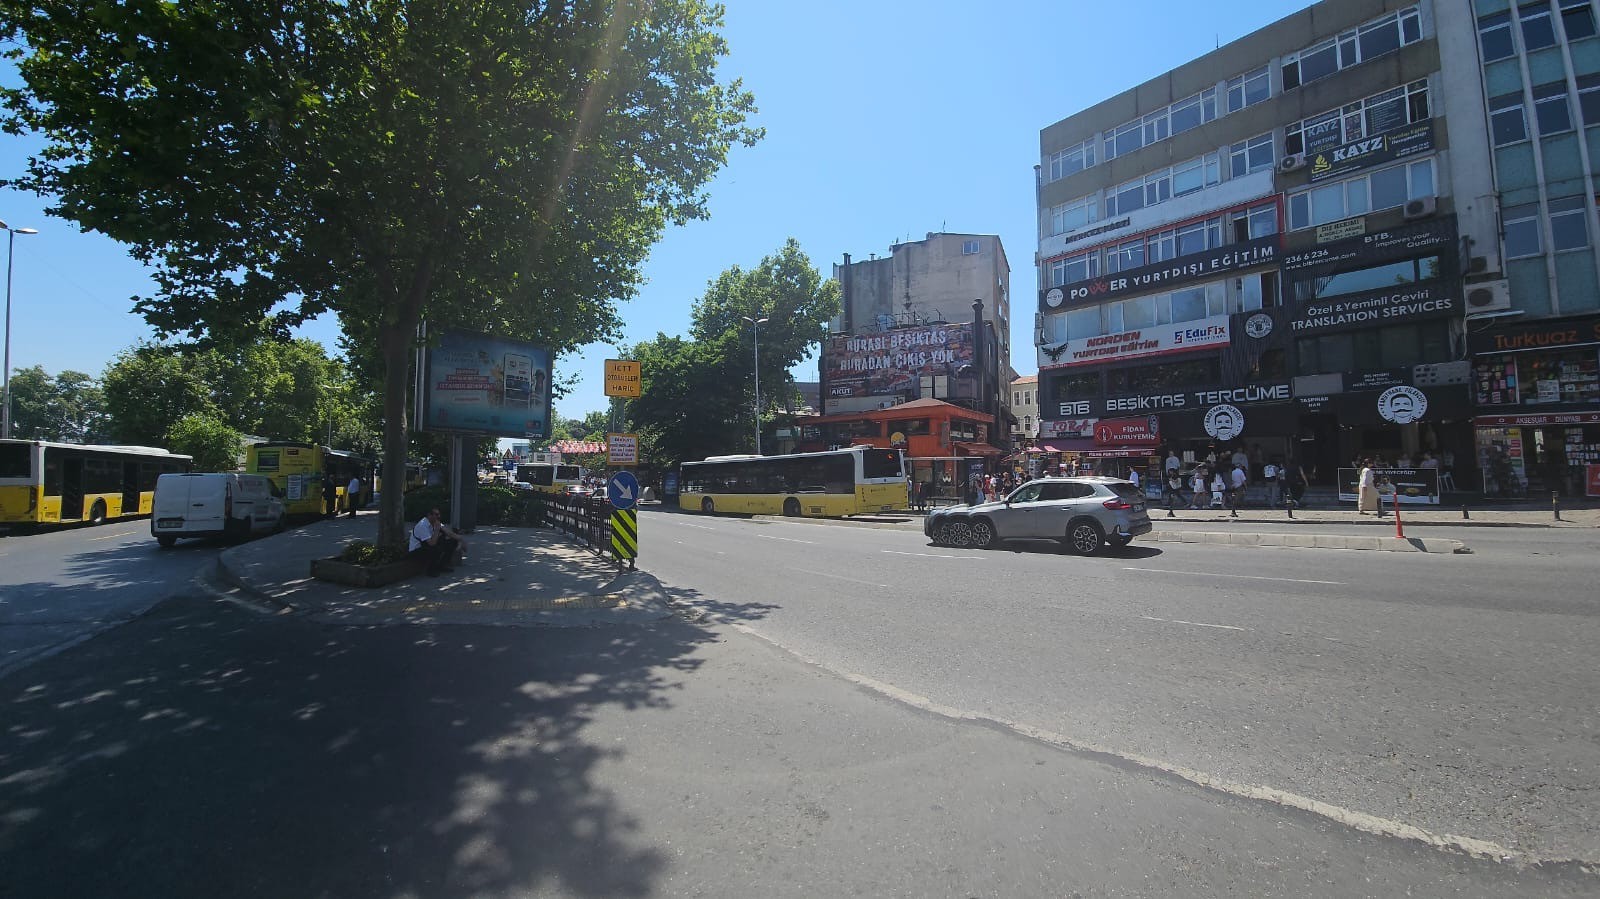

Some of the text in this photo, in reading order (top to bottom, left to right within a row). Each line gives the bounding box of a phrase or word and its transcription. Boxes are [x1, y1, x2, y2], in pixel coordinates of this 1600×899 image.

[1308, 120, 1338, 137] KAYZ
[1333, 136, 1382, 162] KAYZ
[1412, 232, 1430, 243] your
[1285, 249, 1328, 264] 236 6 236
[1133, 262, 1203, 286] YURTDIŞI
[1211, 246, 1273, 268] EĞİTİM
[1308, 306, 1332, 316] Özel
[1392, 290, 1429, 304] Çeviri
[1292, 309, 1378, 330] TRANSLATION
[1383, 298, 1452, 318] SERVICES
[1086, 331, 1141, 348] NORDEN
[1185, 326, 1225, 339] EduFix
[1494, 330, 1578, 348] Turkuaz
[931, 350, 954, 364] YOK
[612, 384, 634, 392] HARİÇ
[1060, 384, 1290, 416] BTB BEŞİKTAŞ TERCÜME
[1113, 432, 1156, 440] KURUYEMİŞ
